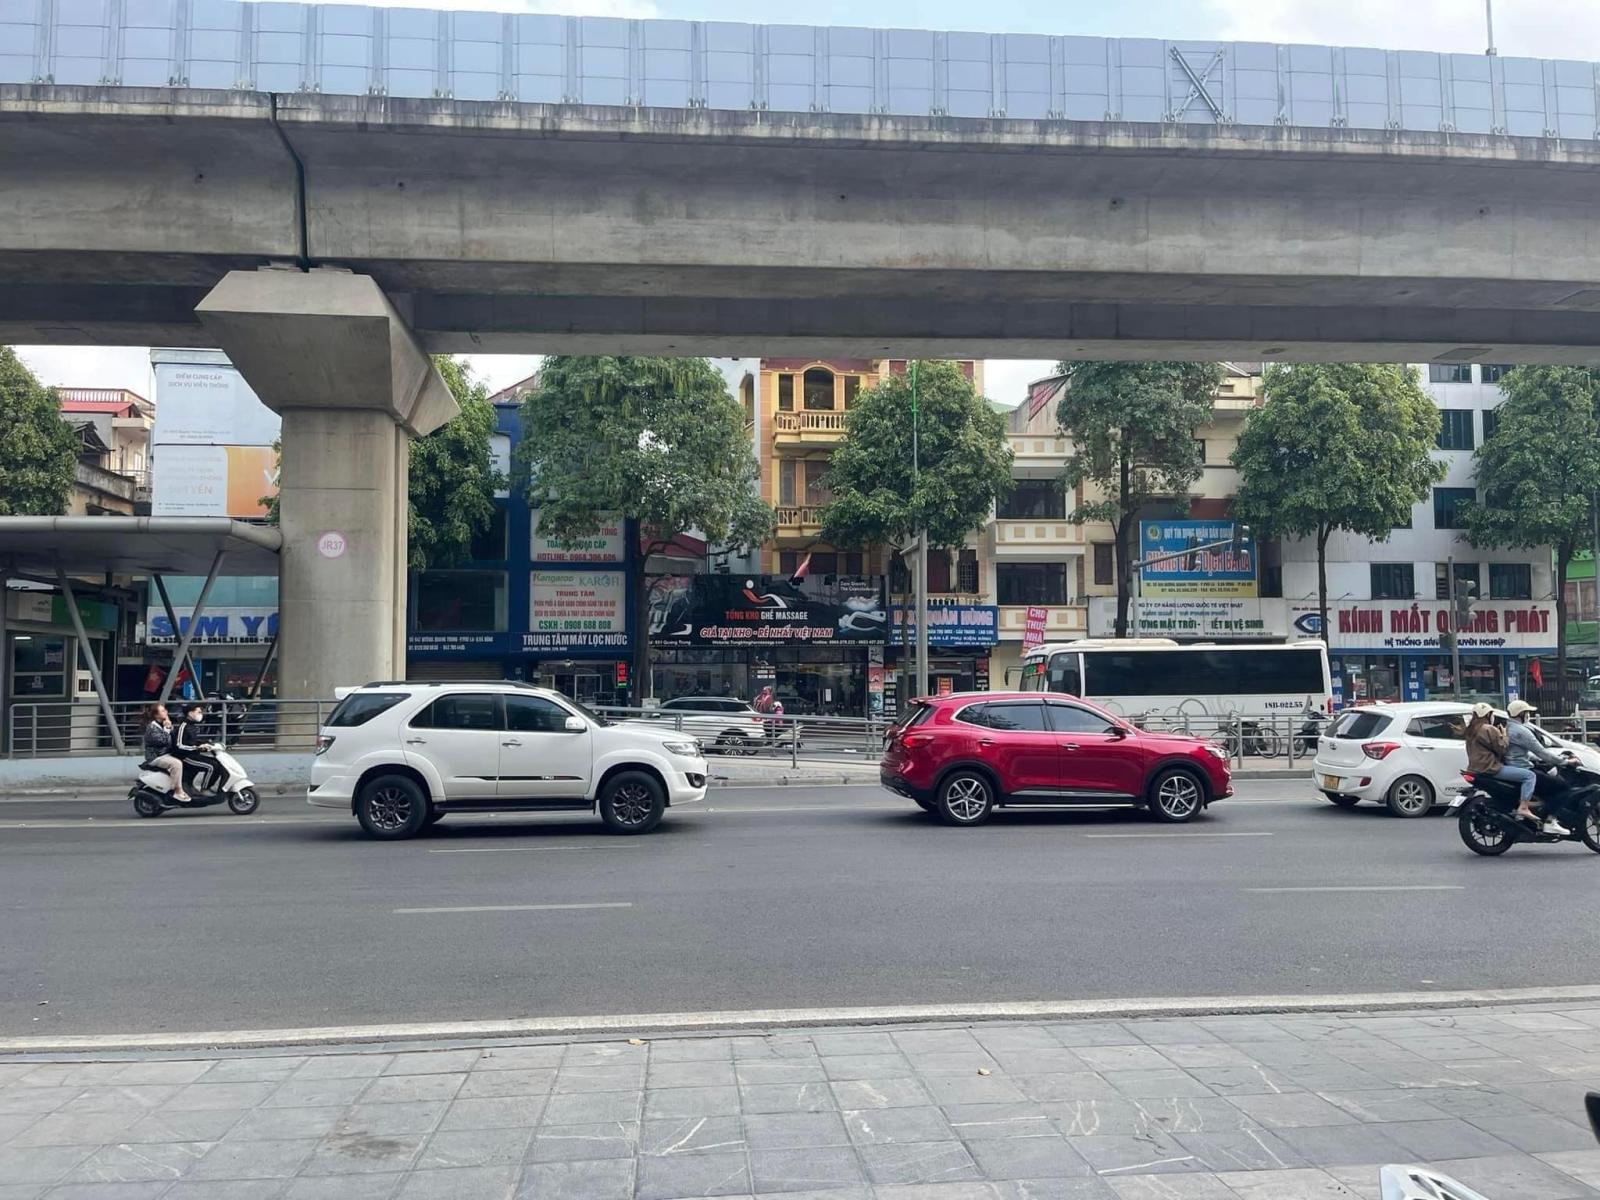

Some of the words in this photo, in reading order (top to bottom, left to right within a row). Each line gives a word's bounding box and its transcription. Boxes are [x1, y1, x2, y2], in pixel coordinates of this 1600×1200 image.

[322, 540, 344, 552] JR37
[532, 572, 575, 584] Kangaroo
[745, 612, 759, 620] KHO
[776, 612, 808, 620] MASSAGE
[1030, 608, 1046, 619] CHO
[1339, 606, 1383, 633] KÍNH
[1391, 603, 1430, 633] MẮT
[1504, 606, 1549, 633] PHÁT
[151, 616, 228, 636] SIM
[539, 620, 558, 630] CSKH
[1160, 618, 1176, 630] MẶT
[1179, 618, 1196, 629] TRỜI
[1224, 620, 1232, 630] BỊ
[1234, 618, 1243, 630] VỆ
[1245, 620, 1264, 629] SINH
[700, 626, 717, 638] GIÁ
[718, 628, 732, 640] TẠI
[733, 628, 752, 638] KHO
[770, 624, 793, 638] NHẤT
[794, 626, 812, 640] VIỆT
[812, 628, 834, 638] NAM
[523, 634, 551, 646] TRUNG
[552, 633, 569, 646] TÂM
[570, 632, 587, 646] MÁY
[588, 634, 604, 648] LỌC
[605, 632, 628, 646] NƯỚC
[1396, 636, 1422, 646] THỐNG
[1479, 638, 1506, 648] NGHIỆP
